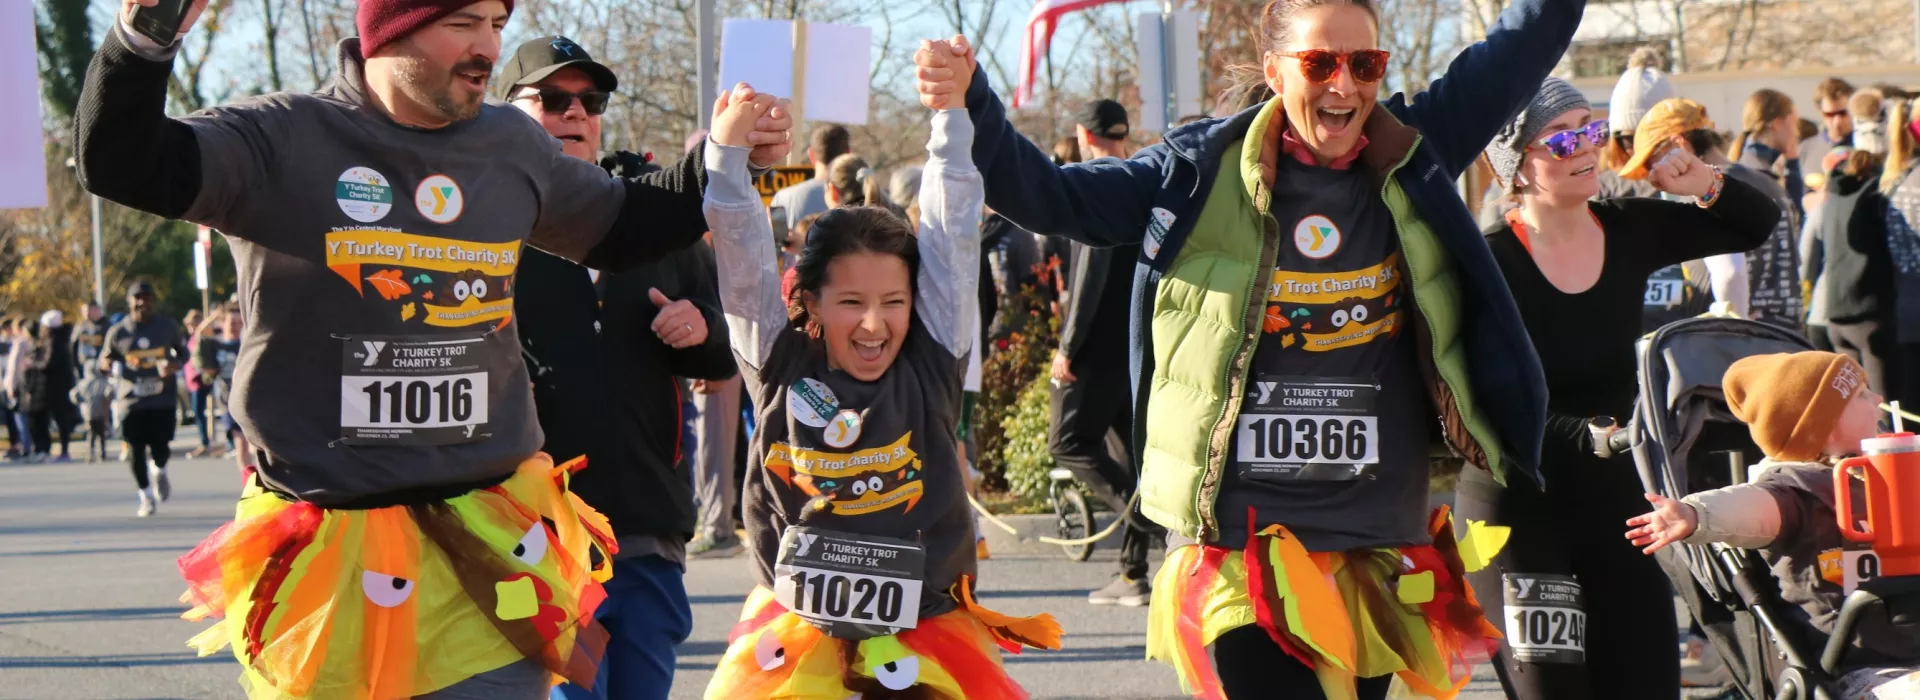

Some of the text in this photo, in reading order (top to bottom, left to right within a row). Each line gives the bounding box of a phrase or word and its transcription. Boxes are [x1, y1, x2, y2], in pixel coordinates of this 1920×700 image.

[350, 183, 371, 194] Turkey
[754, 172, 805, 194] LOW
[349, 191, 371, 200] Charity
[327, 241, 516, 266] Y Turkey Trot Charity 5K
[1285, 279, 1319, 295] Trot
[1321, 275, 1377, 293] Charity
[1380, 265, 1394, 284] 5K
[392, 345, 467, 358] Y TURKEY TROT
[392, 357, 452, 368] CHARITY 5K
[1283, 388, 1354, 398] Y TURKEY TROT
[362, 377, 473, 425] 11016
[1283, 397, 1339, 407] CHARITY 5K
[1248, 417, 1367, 461] 10366
[818, 458, 845, 470] Trot
[847, 451, 891, 468] Charity
[893, 445, 907, 460] 5K
[822, 542, 899, 559] Y TURKEY TROT
[821, 552, 865, 565] CHARITY
[866, 557, 880, 567] 5K
[790, 570, 904, 623] 11020
[1539, 584, 1546, 592] Y
[1546, 584, 1570, 594] TURKEY
[1539, 592, 1569, 601] CHARITY
